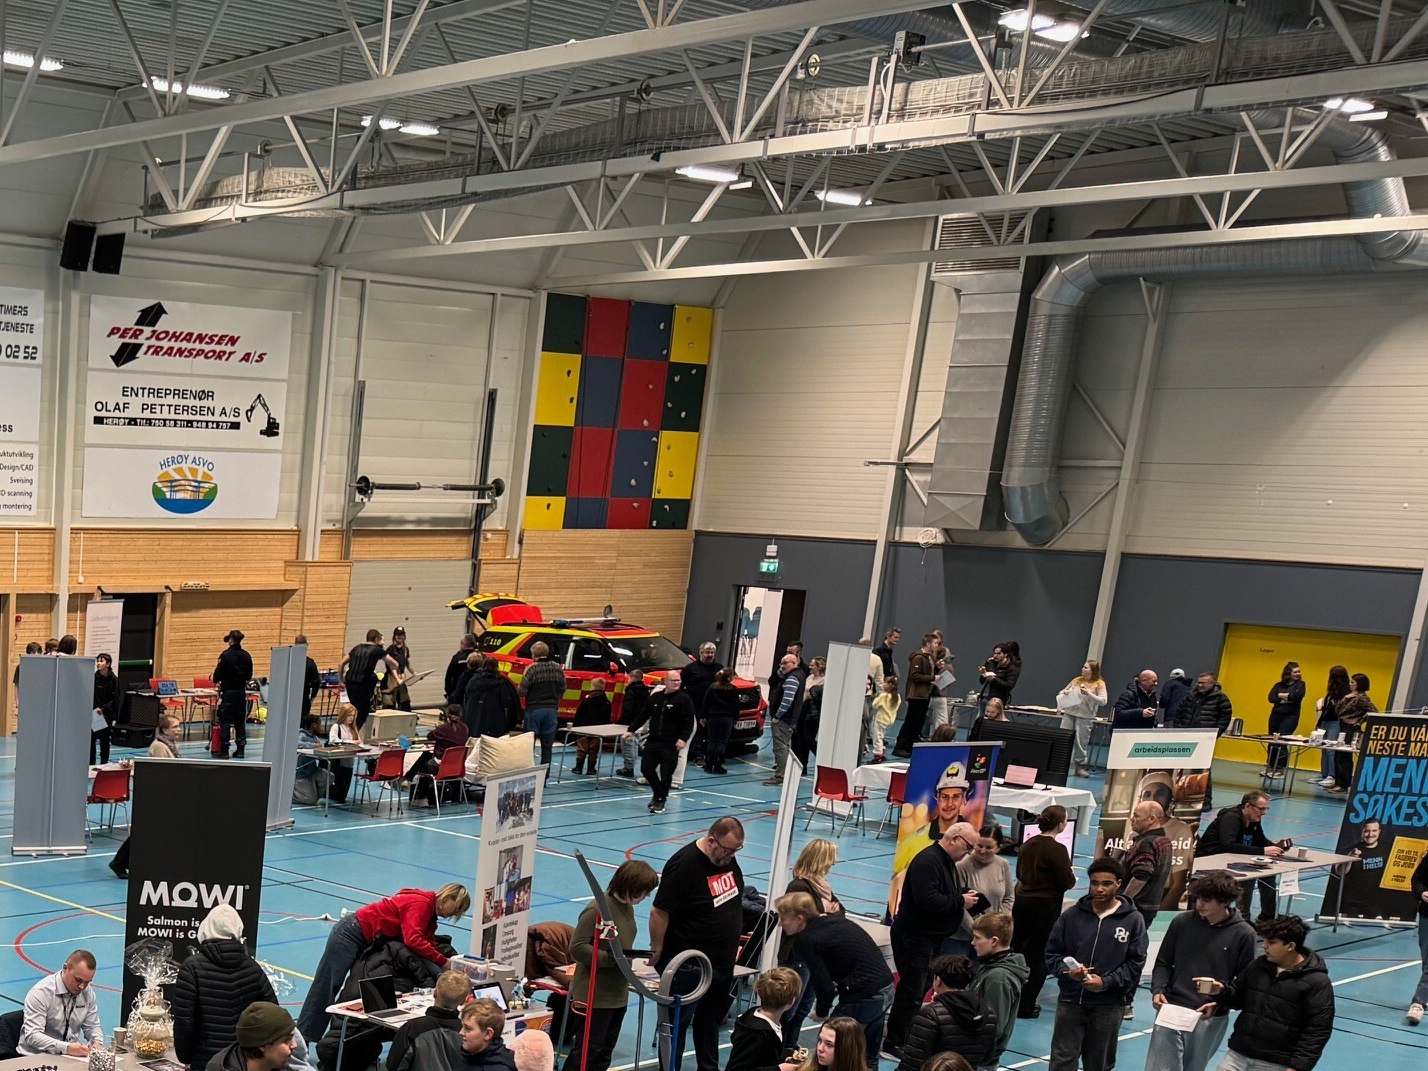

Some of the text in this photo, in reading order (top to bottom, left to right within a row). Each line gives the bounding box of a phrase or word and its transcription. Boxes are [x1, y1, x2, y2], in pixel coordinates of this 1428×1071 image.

[0, 304, 29, 317] TIMERS
[106, 326, 241, 347] PER JOHANSEN
[5, 344, 20, 359] 02
[23, 345, 38, 360] 52
[143, 345, 237, 362] TRANSPORT
[122, 386, 215, 401] ENTREPRENØR
[94, 401, 241, 418] OLAF PETTERSEN A/S
[103, 417, 129, 426] HERØY
[0, 463, 34, 472] Design/CAD
[159, 454, 214, 472] HERØY ASVO
[2, 502, 32, 511] montering
[1370, 725, 1387, 740] ER
[1389, 726, 1408, 741] DU
[1134, 745, 1191, 754] arbeidsplassen
[1366, 740, 1428, 757] NESTE MA
[1104, 837, 1124, 850] Alt
[712, 873, 736, 896] MOT
[139, 880, 243, 911] MOWI
[147, 915, 200, 928] Salmon is
[137, 927, 172, 938] MOWI
[176, 928, 184, 939] is
